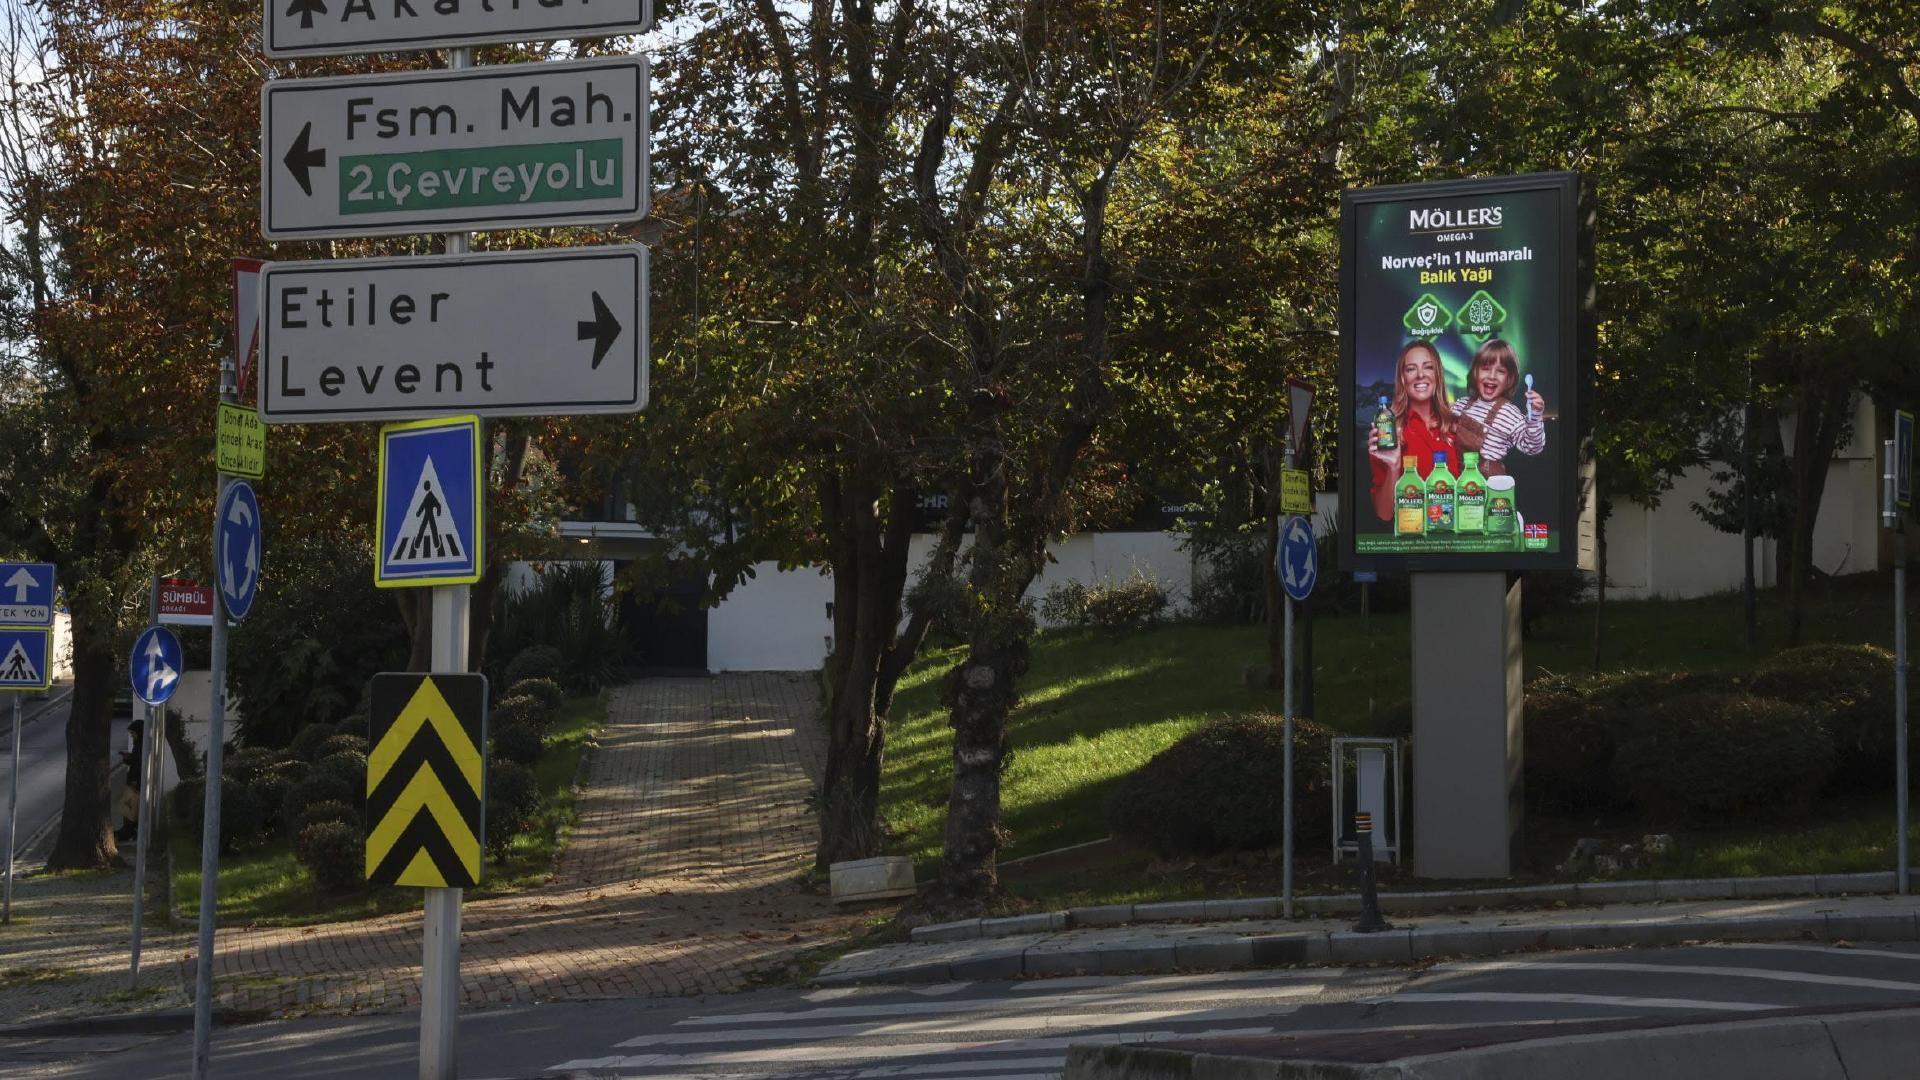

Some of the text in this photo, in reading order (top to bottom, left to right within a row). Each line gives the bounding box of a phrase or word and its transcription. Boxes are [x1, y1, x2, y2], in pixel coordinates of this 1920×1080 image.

[347, 82, 632, 140] Fsm. Mah.
[347, 148, 615, 205] 2.Çevreyolu
[1436, 232, 1474, 242] OMEGA-3
[1381, 247, 1533, 270] Norveç'in 1 Numaralı
[1420, 266, 1492, 284] Balık Yağı
[281, 283, 450, 329] Etiler
[281, 352, 494, 397] Levent
[245, 415, 258, 430] Ada
[162, 590, 208, 605] SÜMBÜL
[24, 607, 45, 618] YÖN
